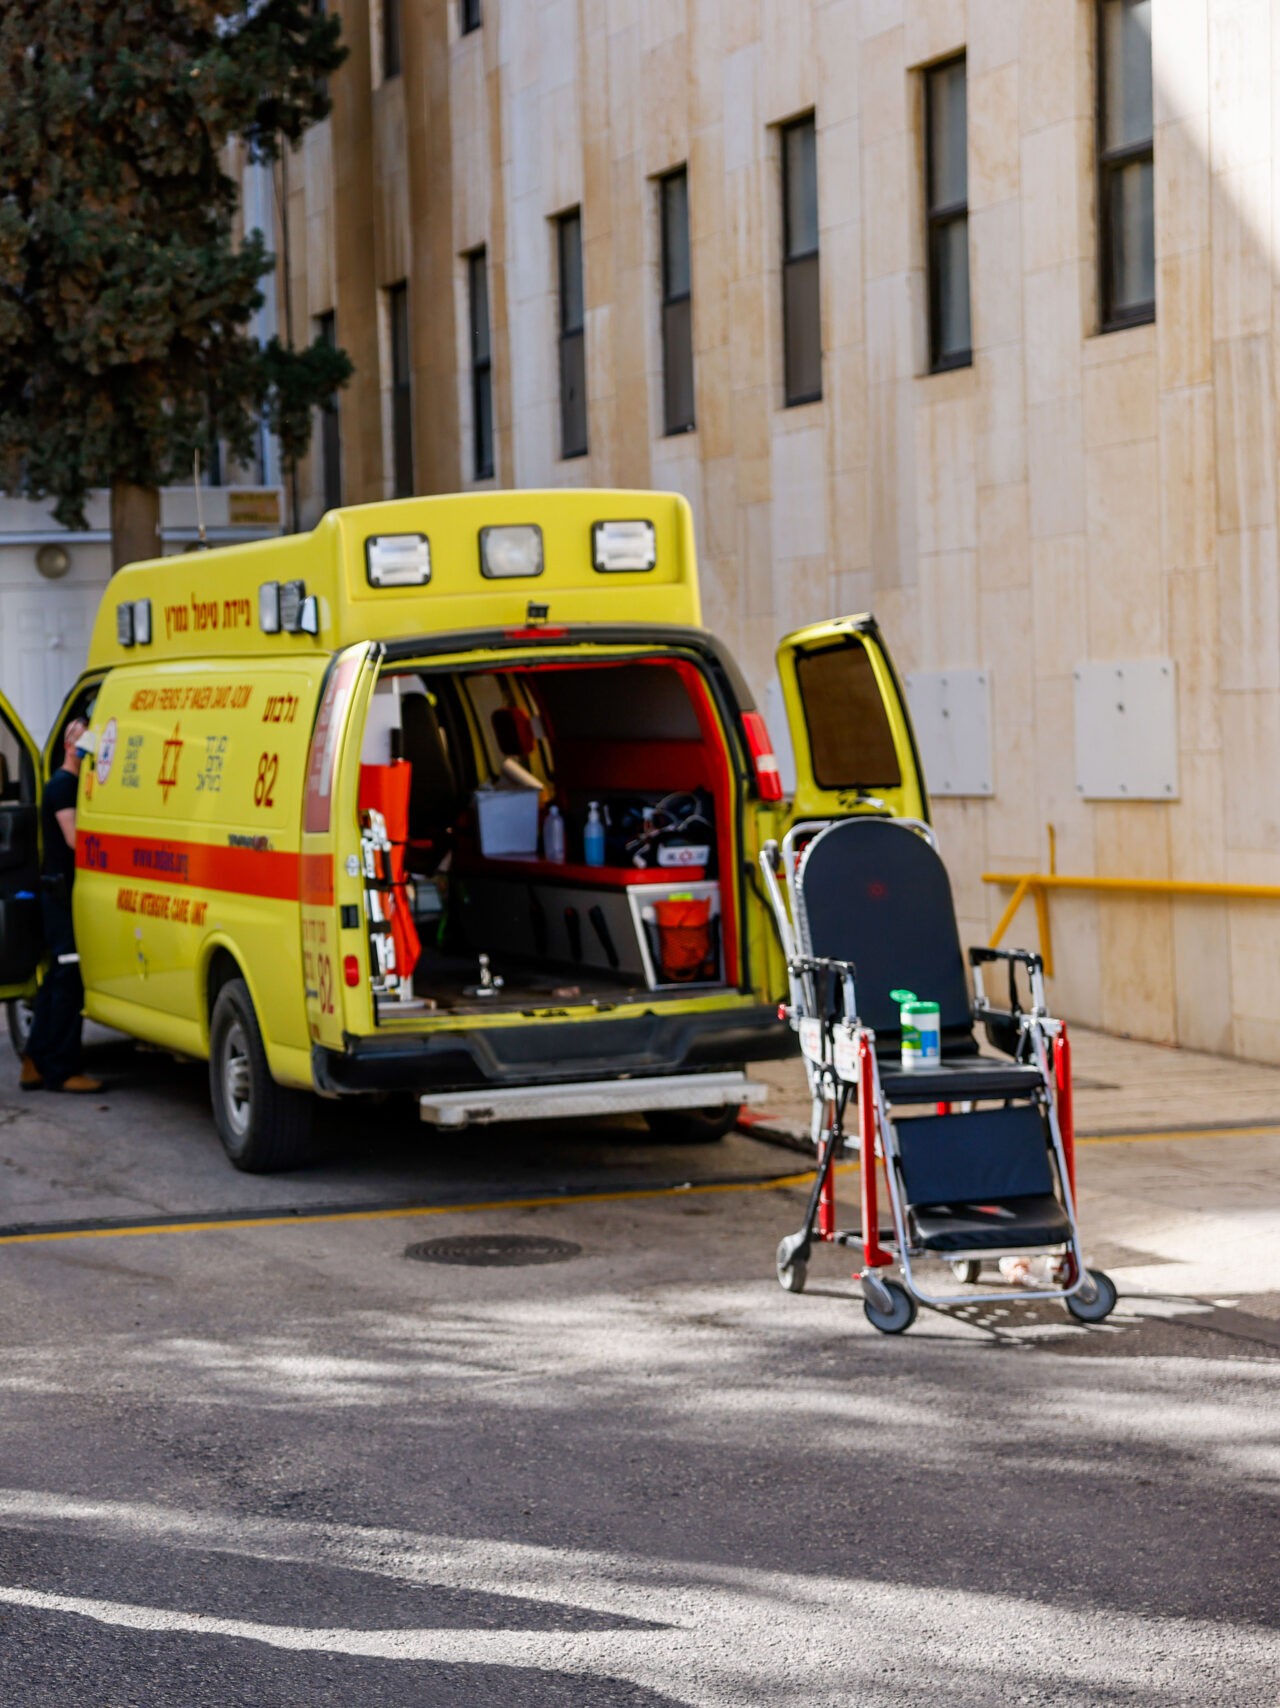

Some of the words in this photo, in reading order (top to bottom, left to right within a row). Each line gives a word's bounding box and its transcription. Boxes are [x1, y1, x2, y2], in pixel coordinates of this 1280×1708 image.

[191, 591, 218, 631] טיפול
[222, 598, 251, 629] ניידת
[253, 752, 279, 808] 82
